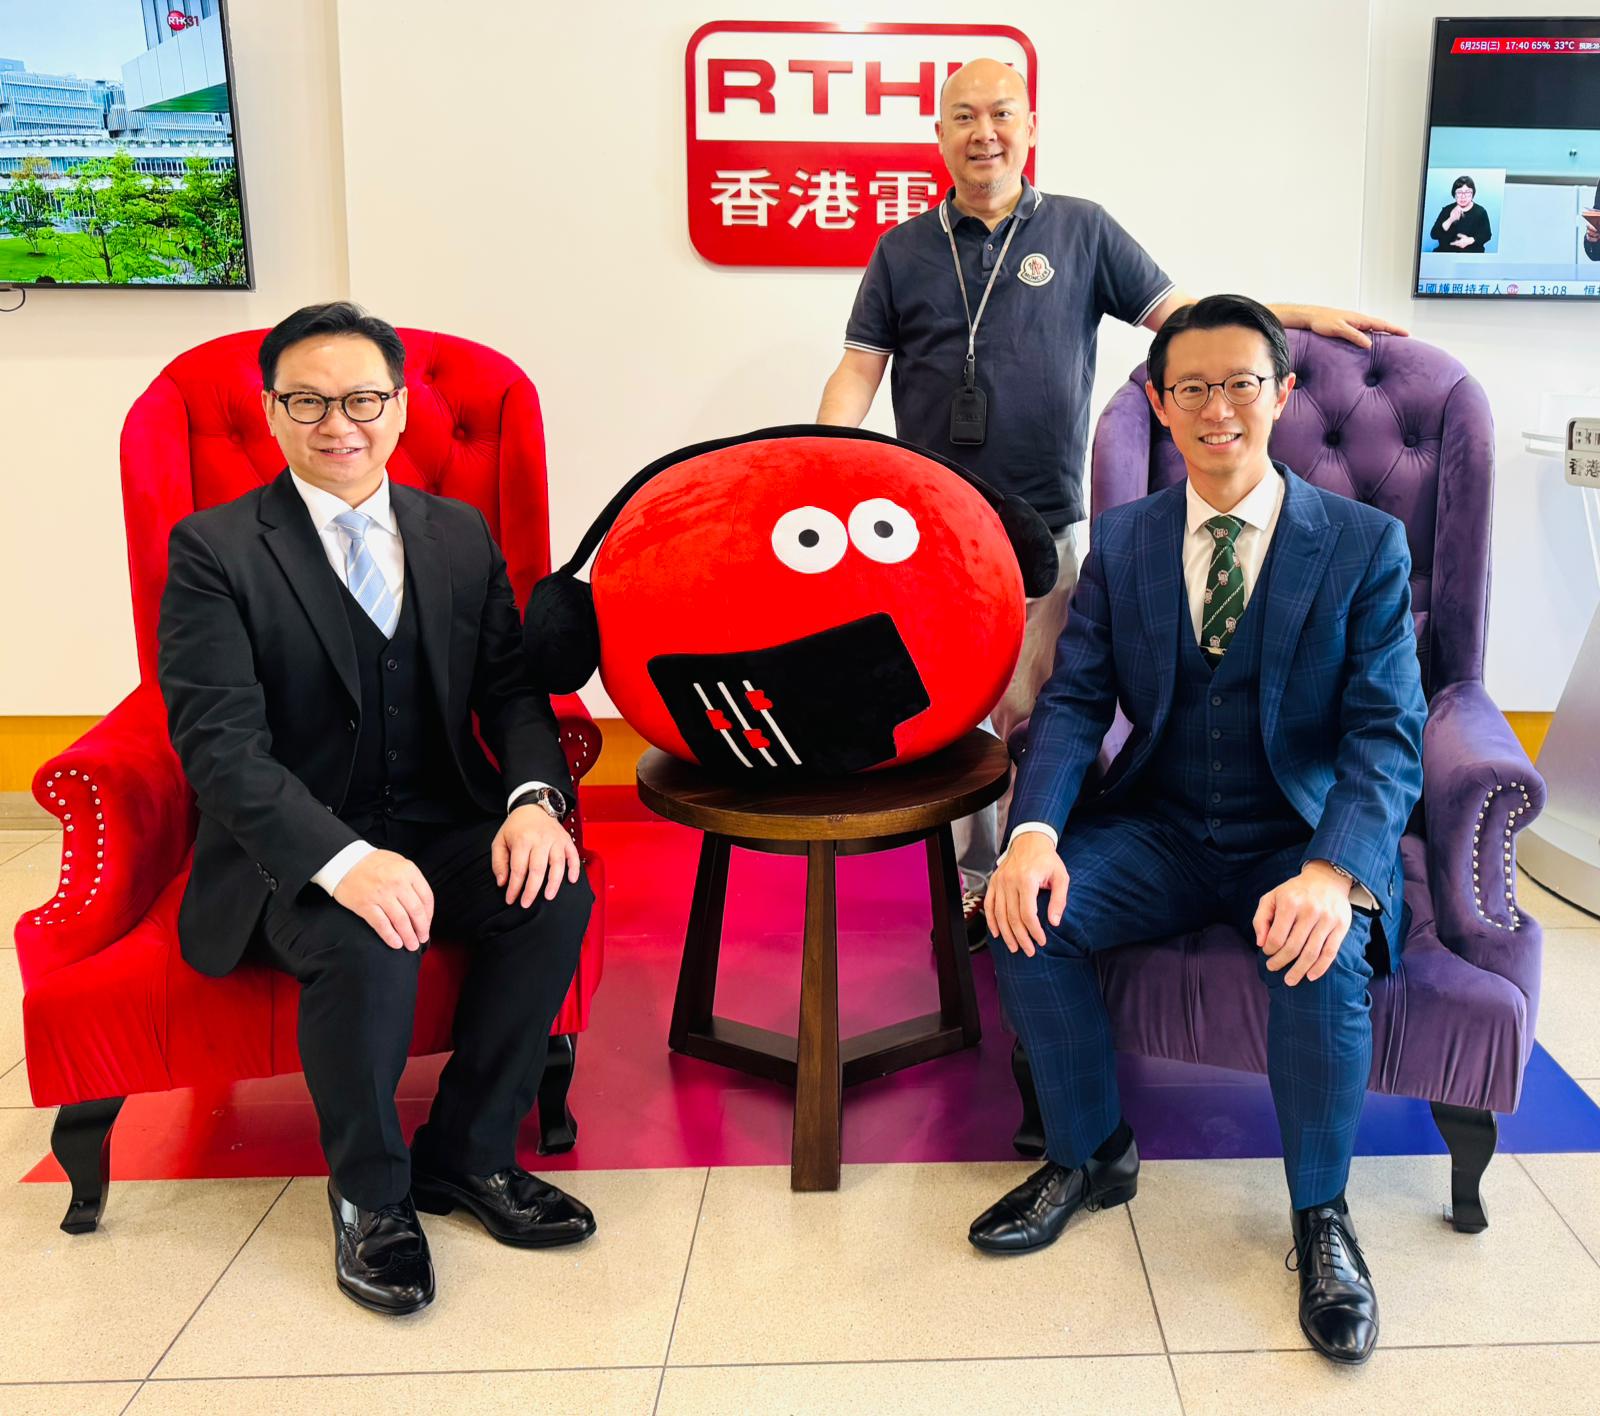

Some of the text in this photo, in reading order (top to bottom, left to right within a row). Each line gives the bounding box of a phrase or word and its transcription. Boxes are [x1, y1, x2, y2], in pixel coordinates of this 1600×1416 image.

[1460, 41, 1500, 51] 6月25日(三)
[1505, 41, 1530, 50] 17:40
[1531, 41, 1551, 50] 65%
[1554, 41, 1575, 50] 33°C
[707, 59, 1013, 115] RTH
[1024, 270, 1048, 281] MONCLER
[1532, 285, 1568, 296] 13:08
[1584, 284, 1600, 296] 恒
